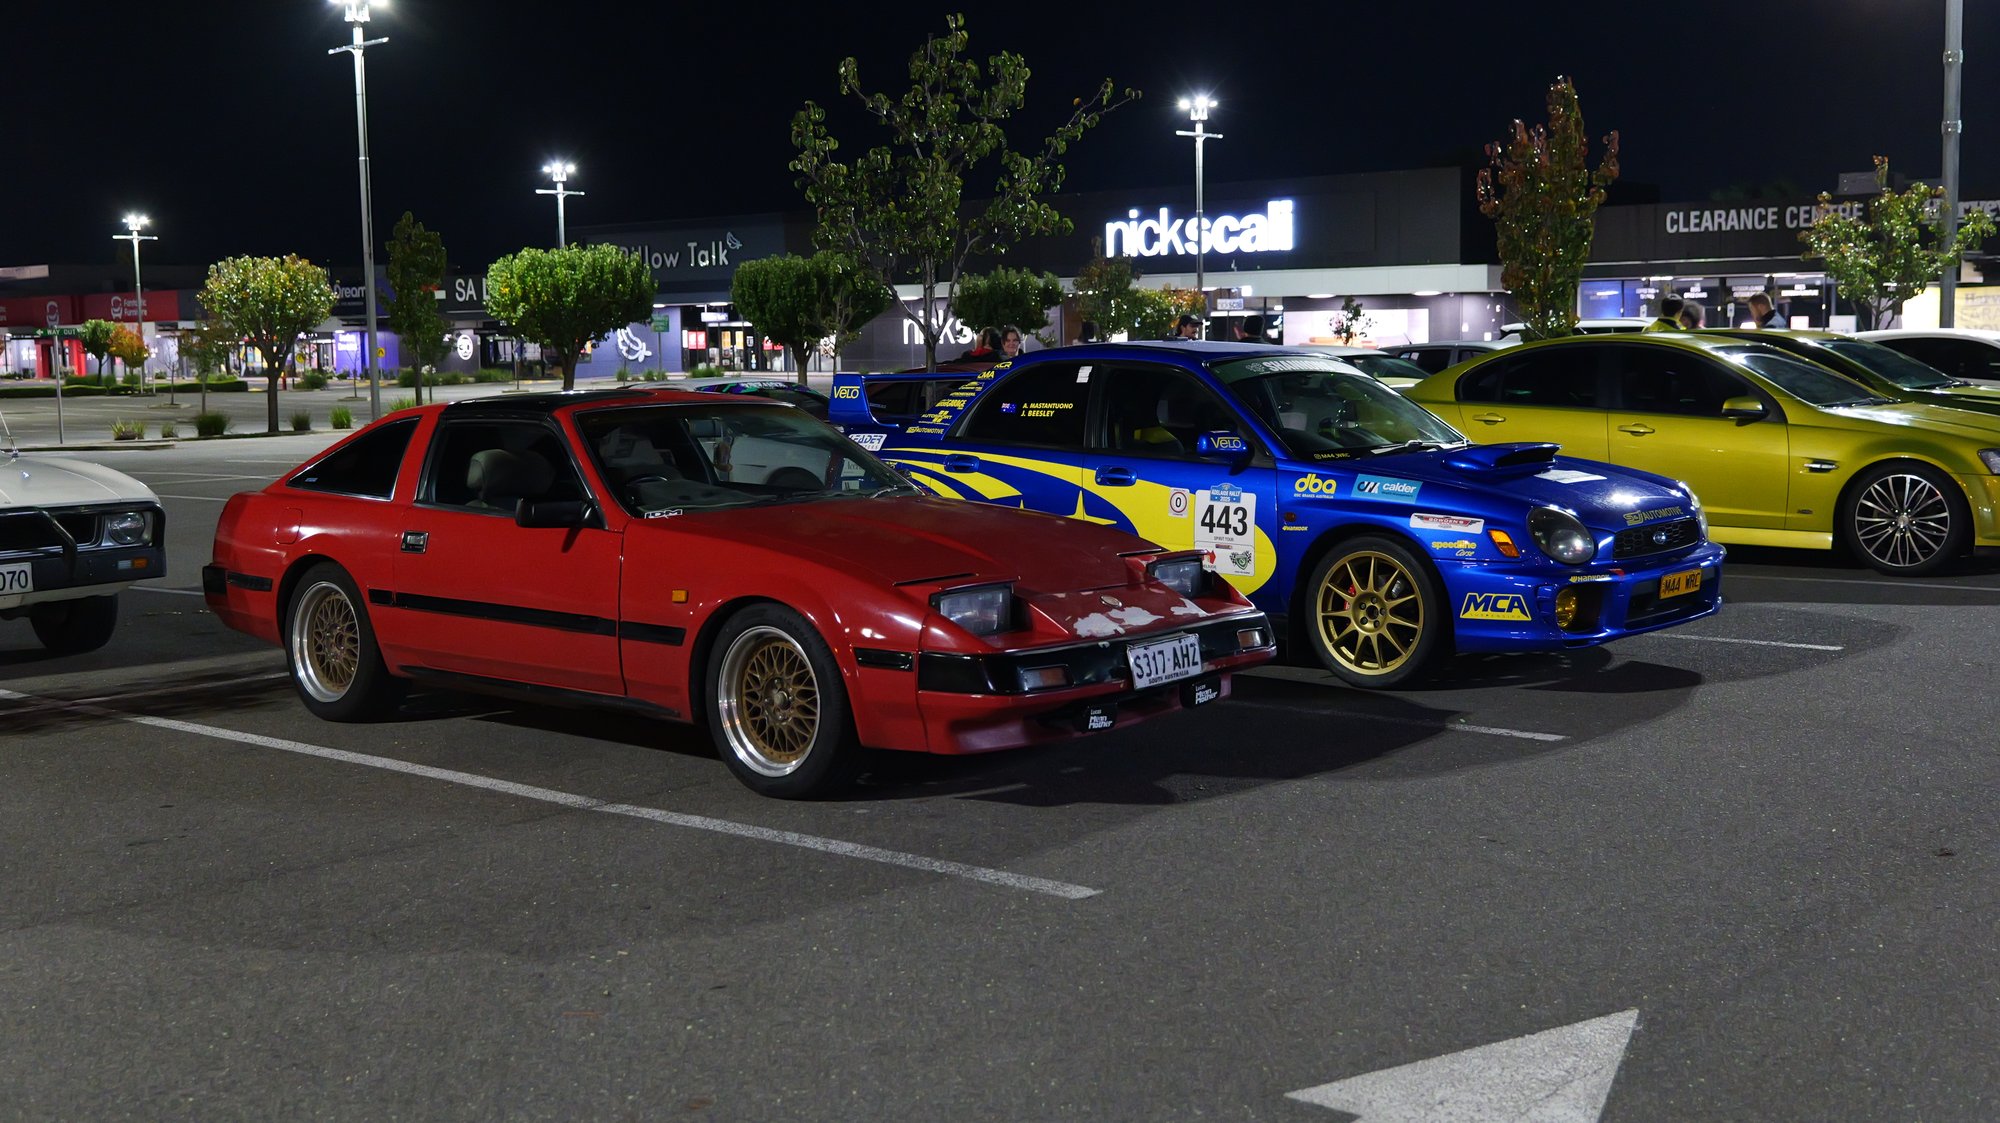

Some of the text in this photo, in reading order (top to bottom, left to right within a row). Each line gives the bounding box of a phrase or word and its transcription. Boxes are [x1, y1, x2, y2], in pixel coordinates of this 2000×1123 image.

[1666, 207, 1778, 234] CLEARANCE
[687, 241, 729, 267] Talk
[455, 278, 477, 302] SA
[47, 327, 76, 336] WAY OUT
[1294, 473, 1337, 495] dba
[1382, 481, 1417, 494] calder
[1175, 497, 1182, 508] 0
[1201, 505, 1248, 536] 443
[1684, 572, 1700, 590] WRC
[1461, 593, 1530, 618] MCA
[1164, 670, 1189, 680] AUSTRALIA
